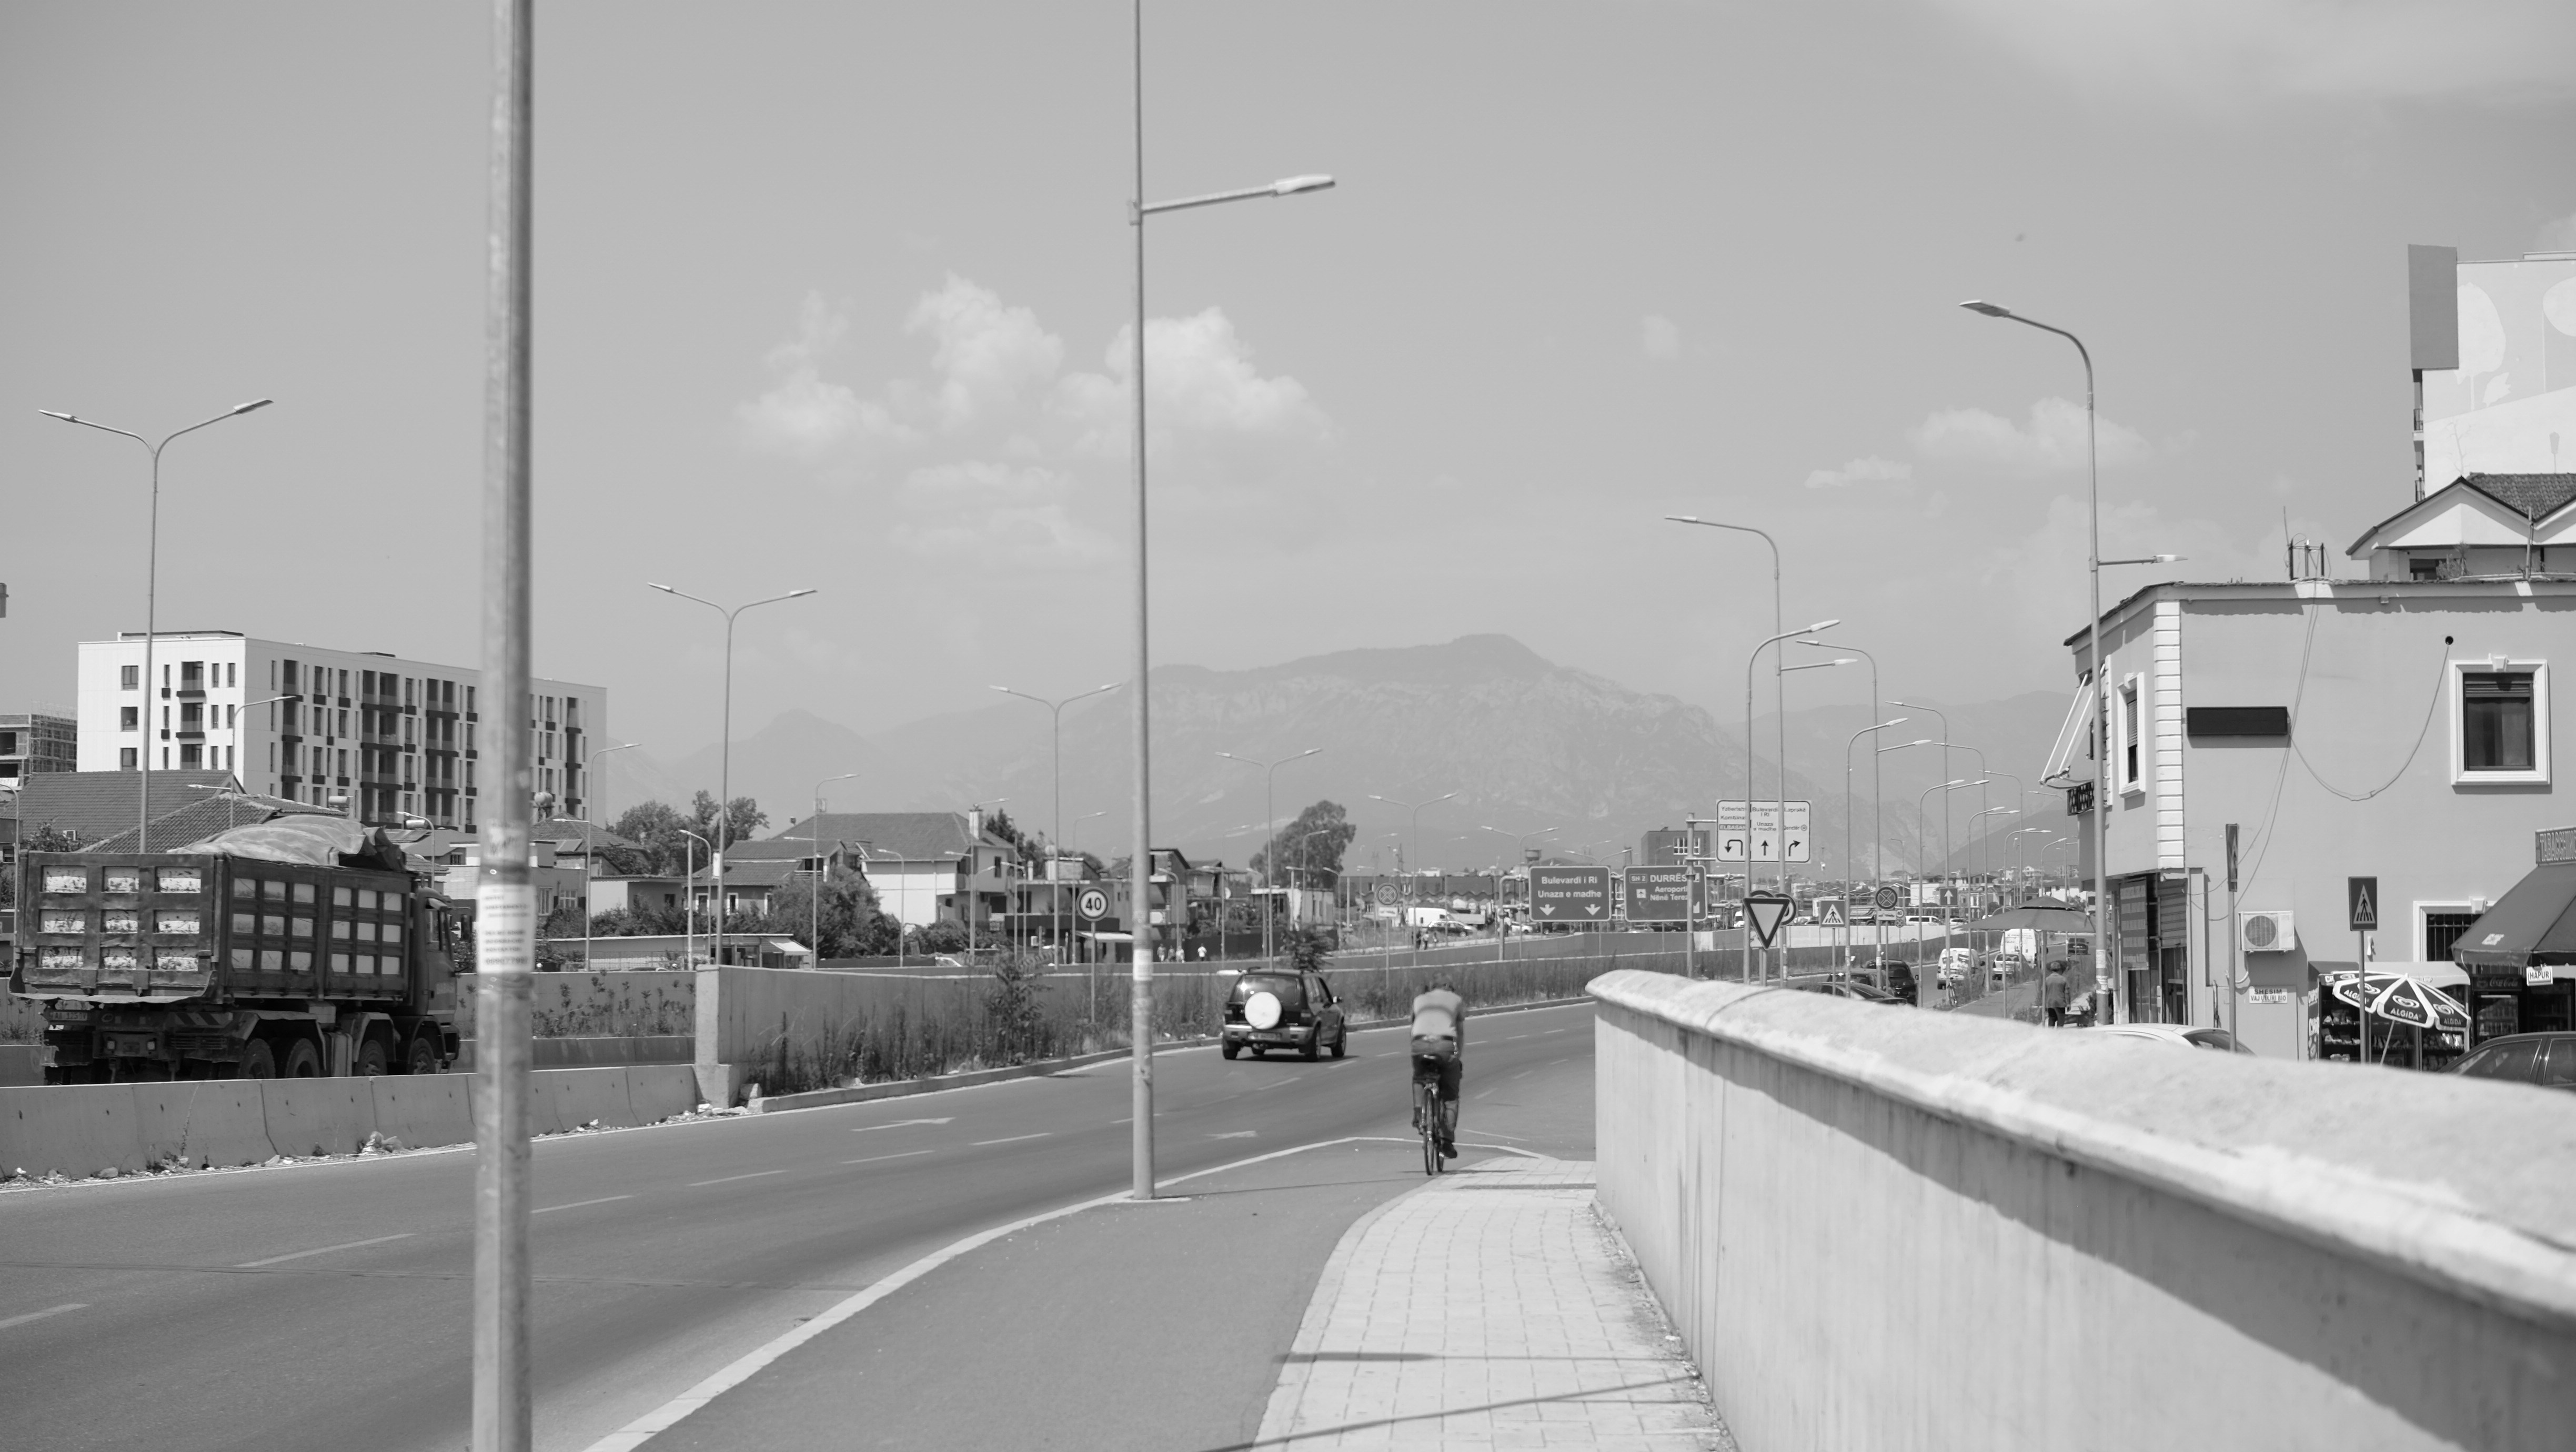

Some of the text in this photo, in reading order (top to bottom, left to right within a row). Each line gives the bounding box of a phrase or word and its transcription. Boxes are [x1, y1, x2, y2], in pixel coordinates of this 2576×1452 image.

[1541, 876, 1582, 884] Bulevardi
[1650, 873, 1687, 882] DURRËS
[1537, 890, 1564, 898] Unaza
[1086, 898, 1101, 911] 40
[2530, 971, 2550, 980] HAPUR
[2390, 1007, 2419, 1021] ALGIDA
